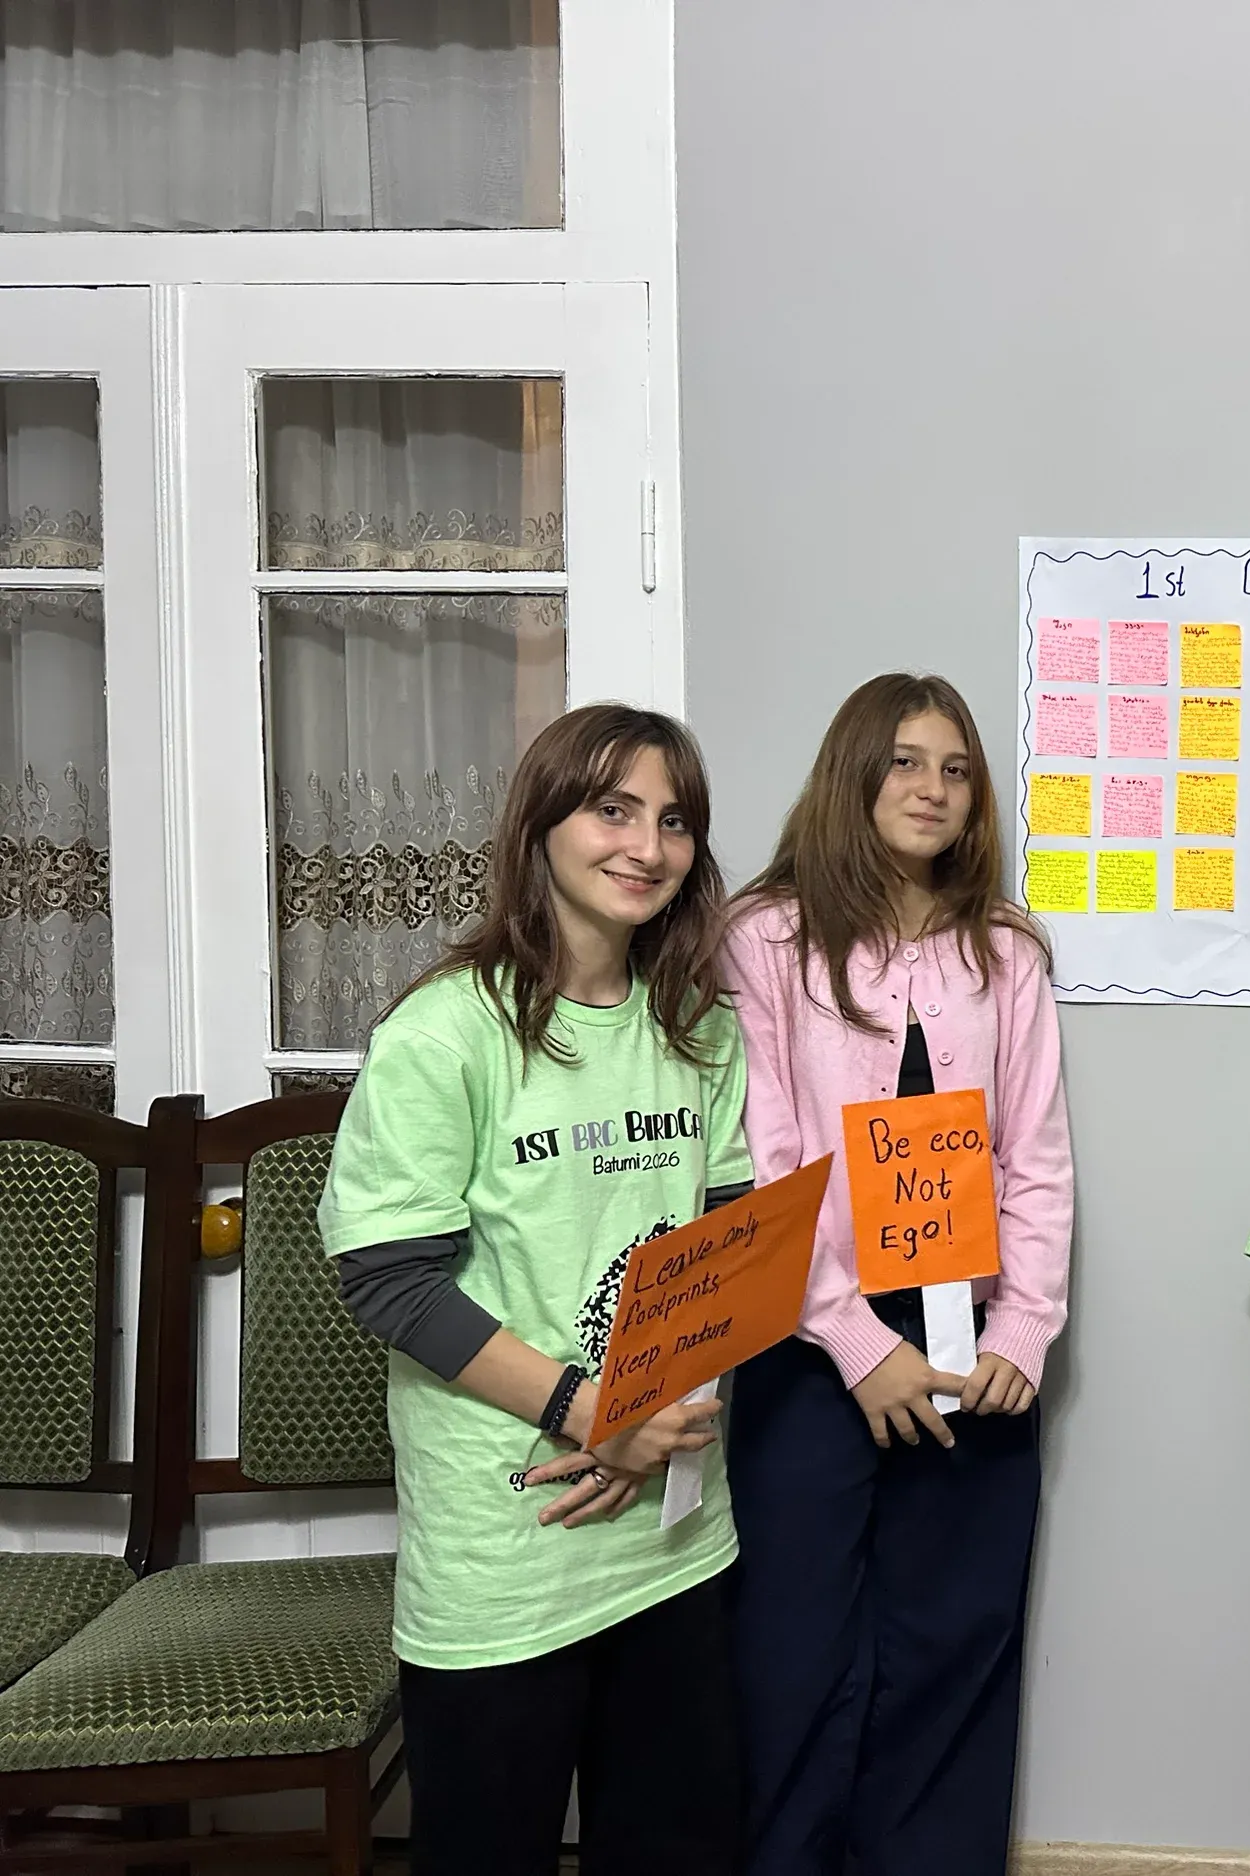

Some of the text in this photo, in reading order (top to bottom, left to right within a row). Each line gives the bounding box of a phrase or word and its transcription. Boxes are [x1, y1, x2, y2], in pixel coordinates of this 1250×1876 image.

[1136, 562, 1186, 598] 1st
[511, 1106, 704, 1165] 1ST BRC BIRDCA
[869, 1118, 985, 1164] Be eco,
[593, 1151, 680, 1175] Batumi 2026
[895, 1167, 953, 1204] Not
[880, 1209, 953, 1262] Ego!
[632, 1239, 713, 1294] Leave
[673, 1316, 733, 1355] nature
